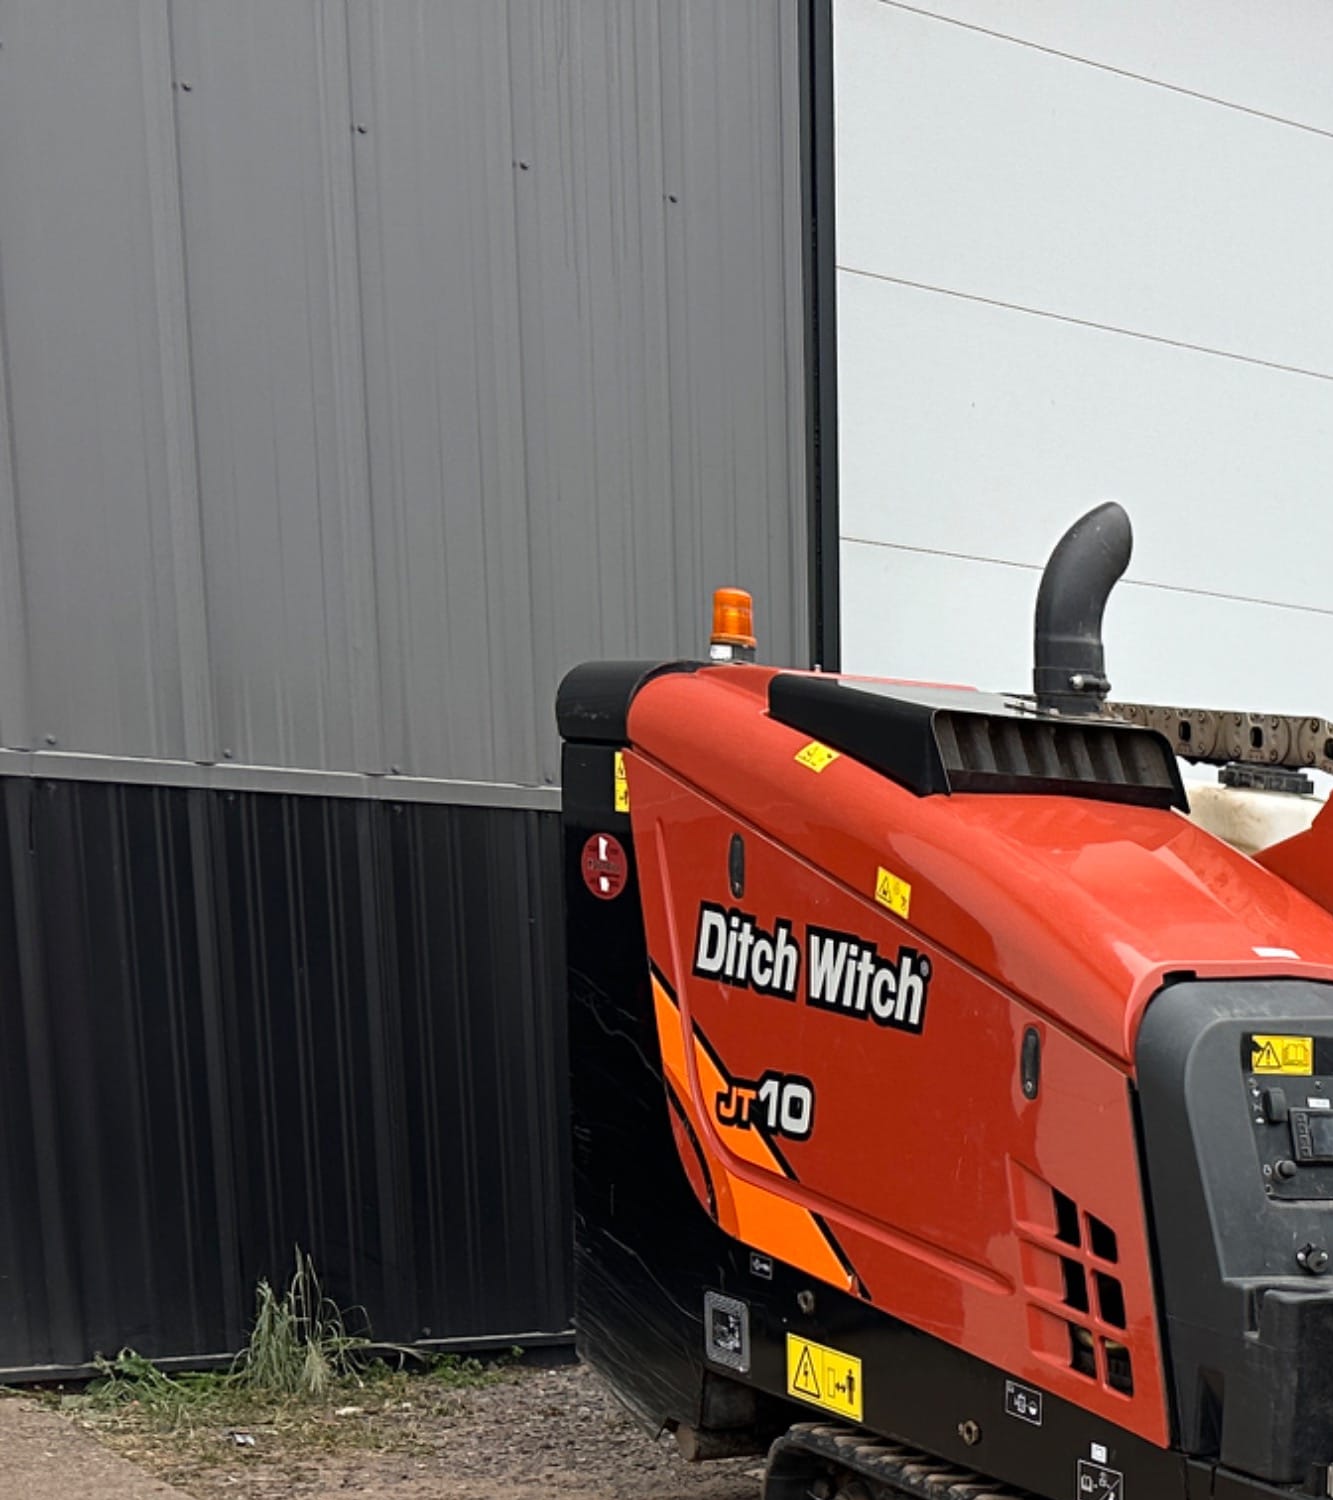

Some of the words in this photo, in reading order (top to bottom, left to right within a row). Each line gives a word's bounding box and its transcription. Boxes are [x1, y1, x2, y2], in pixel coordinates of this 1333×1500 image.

[696, 909, 798, 992] Ditch
[809, 933, 924, 1025] Witch
[720, 1079, 812, 1134] JT10
